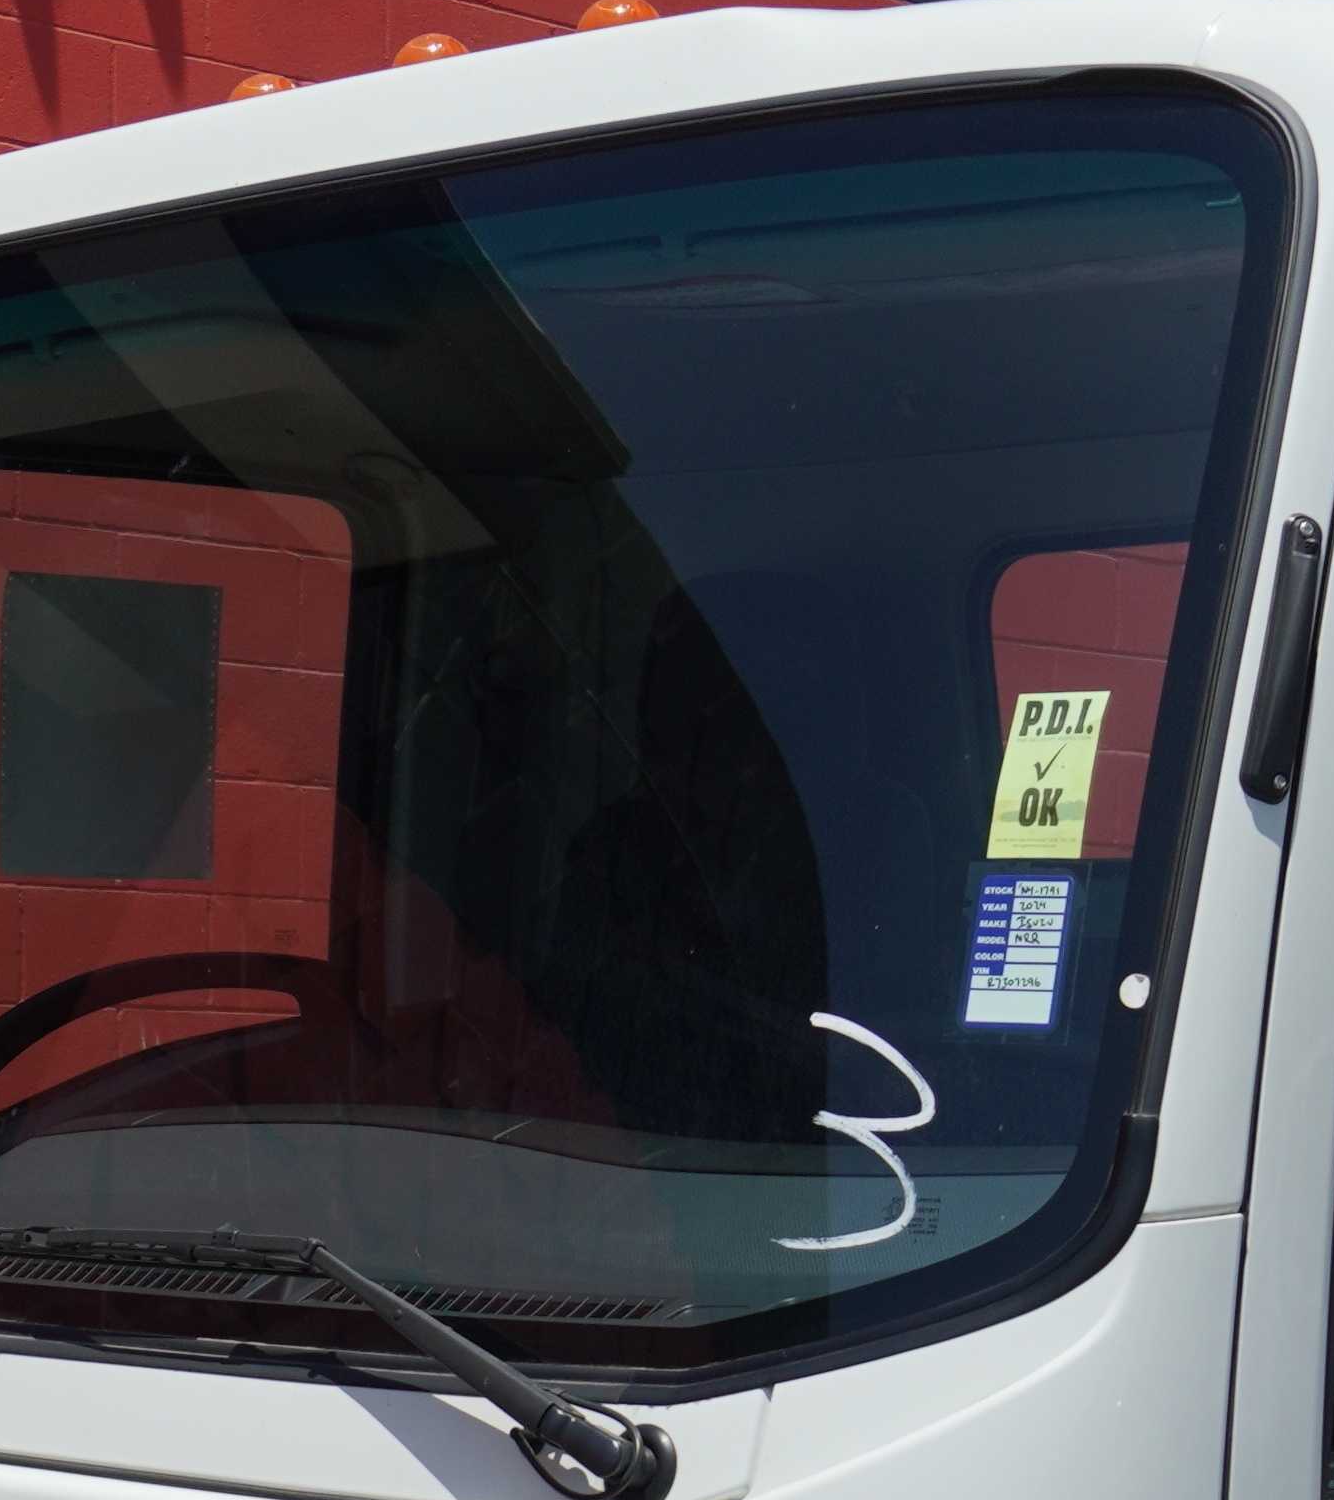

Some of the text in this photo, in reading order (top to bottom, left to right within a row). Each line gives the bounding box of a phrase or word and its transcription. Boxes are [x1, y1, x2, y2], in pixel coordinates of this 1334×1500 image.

[1018, 697, 1094, 737] P.D.I.
[1018, 787, 1064, 828] OK
[983, 885, 1014, 895] STOCK
[982, 900, 1046, 912] YEAR 2024
[978, 919, 1007, 928] MAKE
[976, 935, 1006, 945] MODEL
[974, 951, 1005, 961] COLOR
[972, 965, 990, 975] VIN
[771, 1012, 935, 1250] 3
